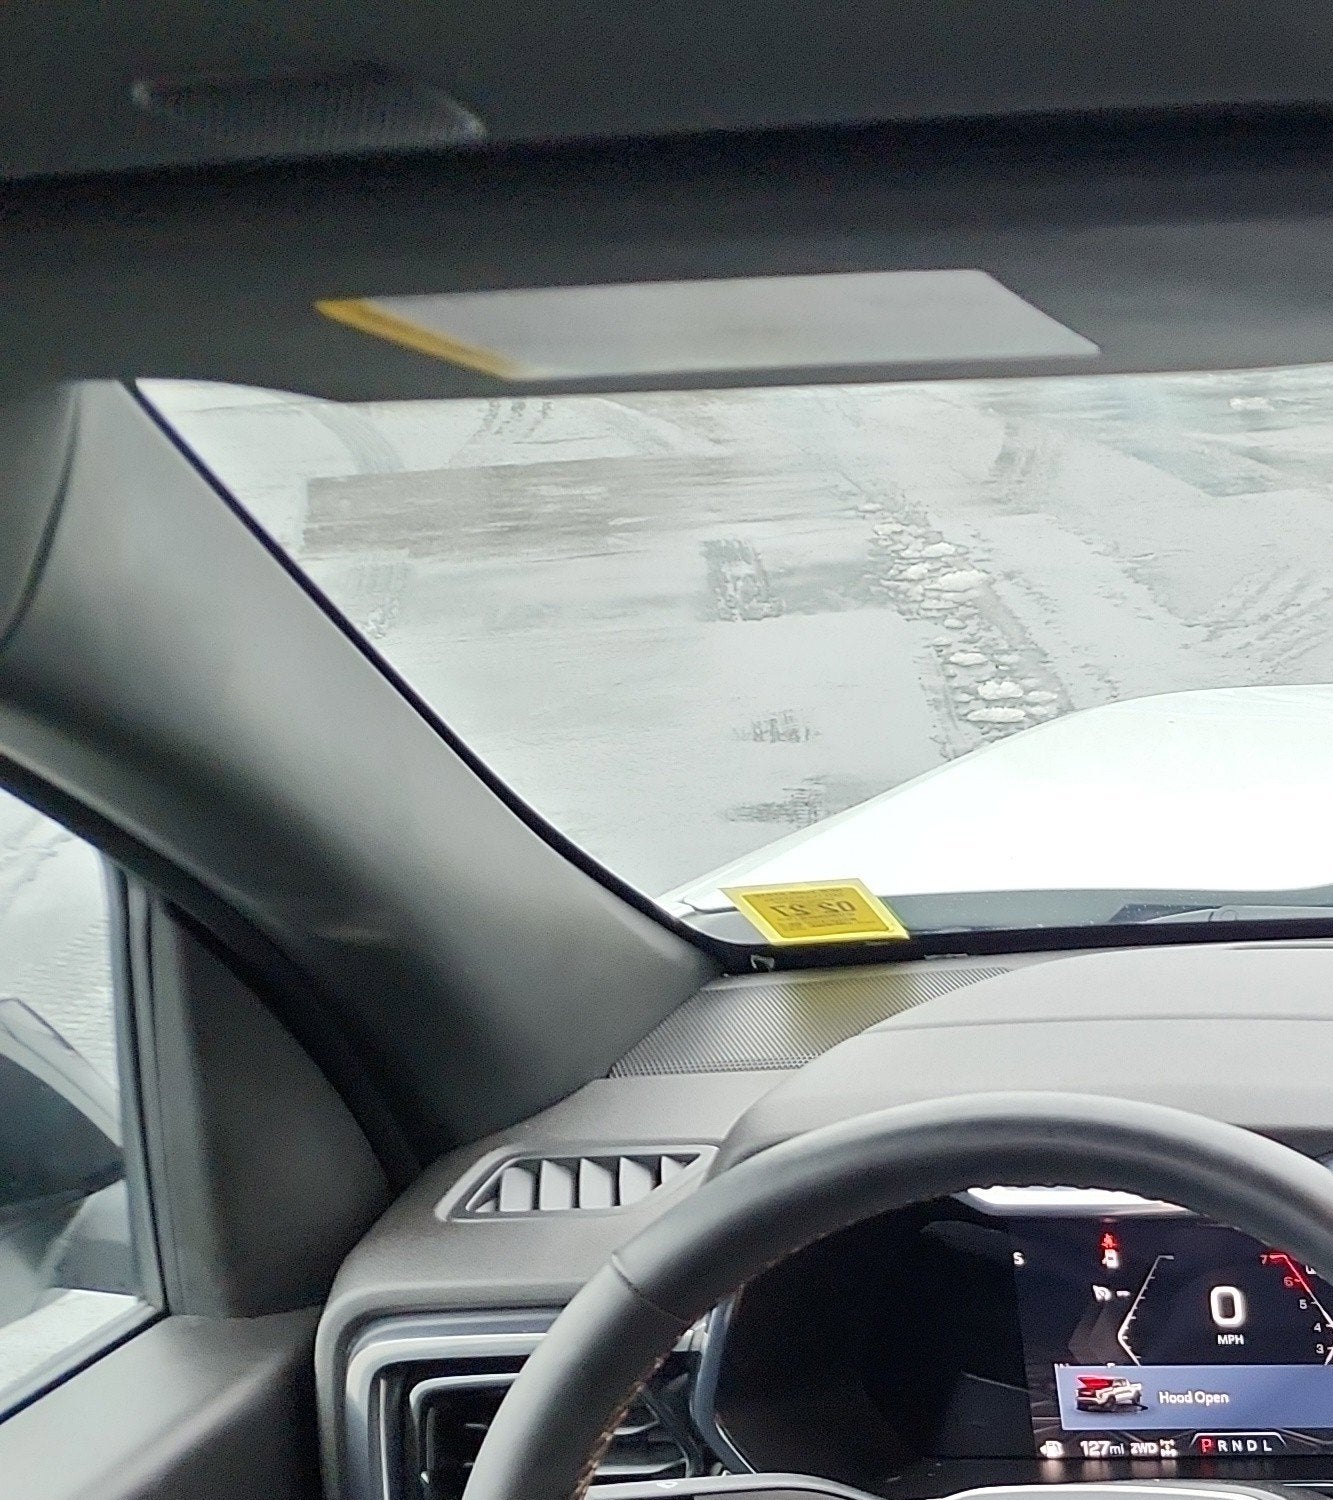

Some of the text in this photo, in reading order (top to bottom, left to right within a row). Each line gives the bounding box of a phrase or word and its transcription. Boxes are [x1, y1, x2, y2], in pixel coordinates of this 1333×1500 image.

[1210, 1286, 1243, 1327] 0
[1299, 1299, 1307, 1310] 5
[1314, 1323, 1321, 1332] 4
[1218, 1334, 1244, 1345] MPH
[1316, 1344, 1324, 1354] 3
[1159, 1391, 1229, 1406] Hood Open
[1131, 1443, 1158, 1455] 2WD
[1202, 1439, 1271, 1451] P R N D L
